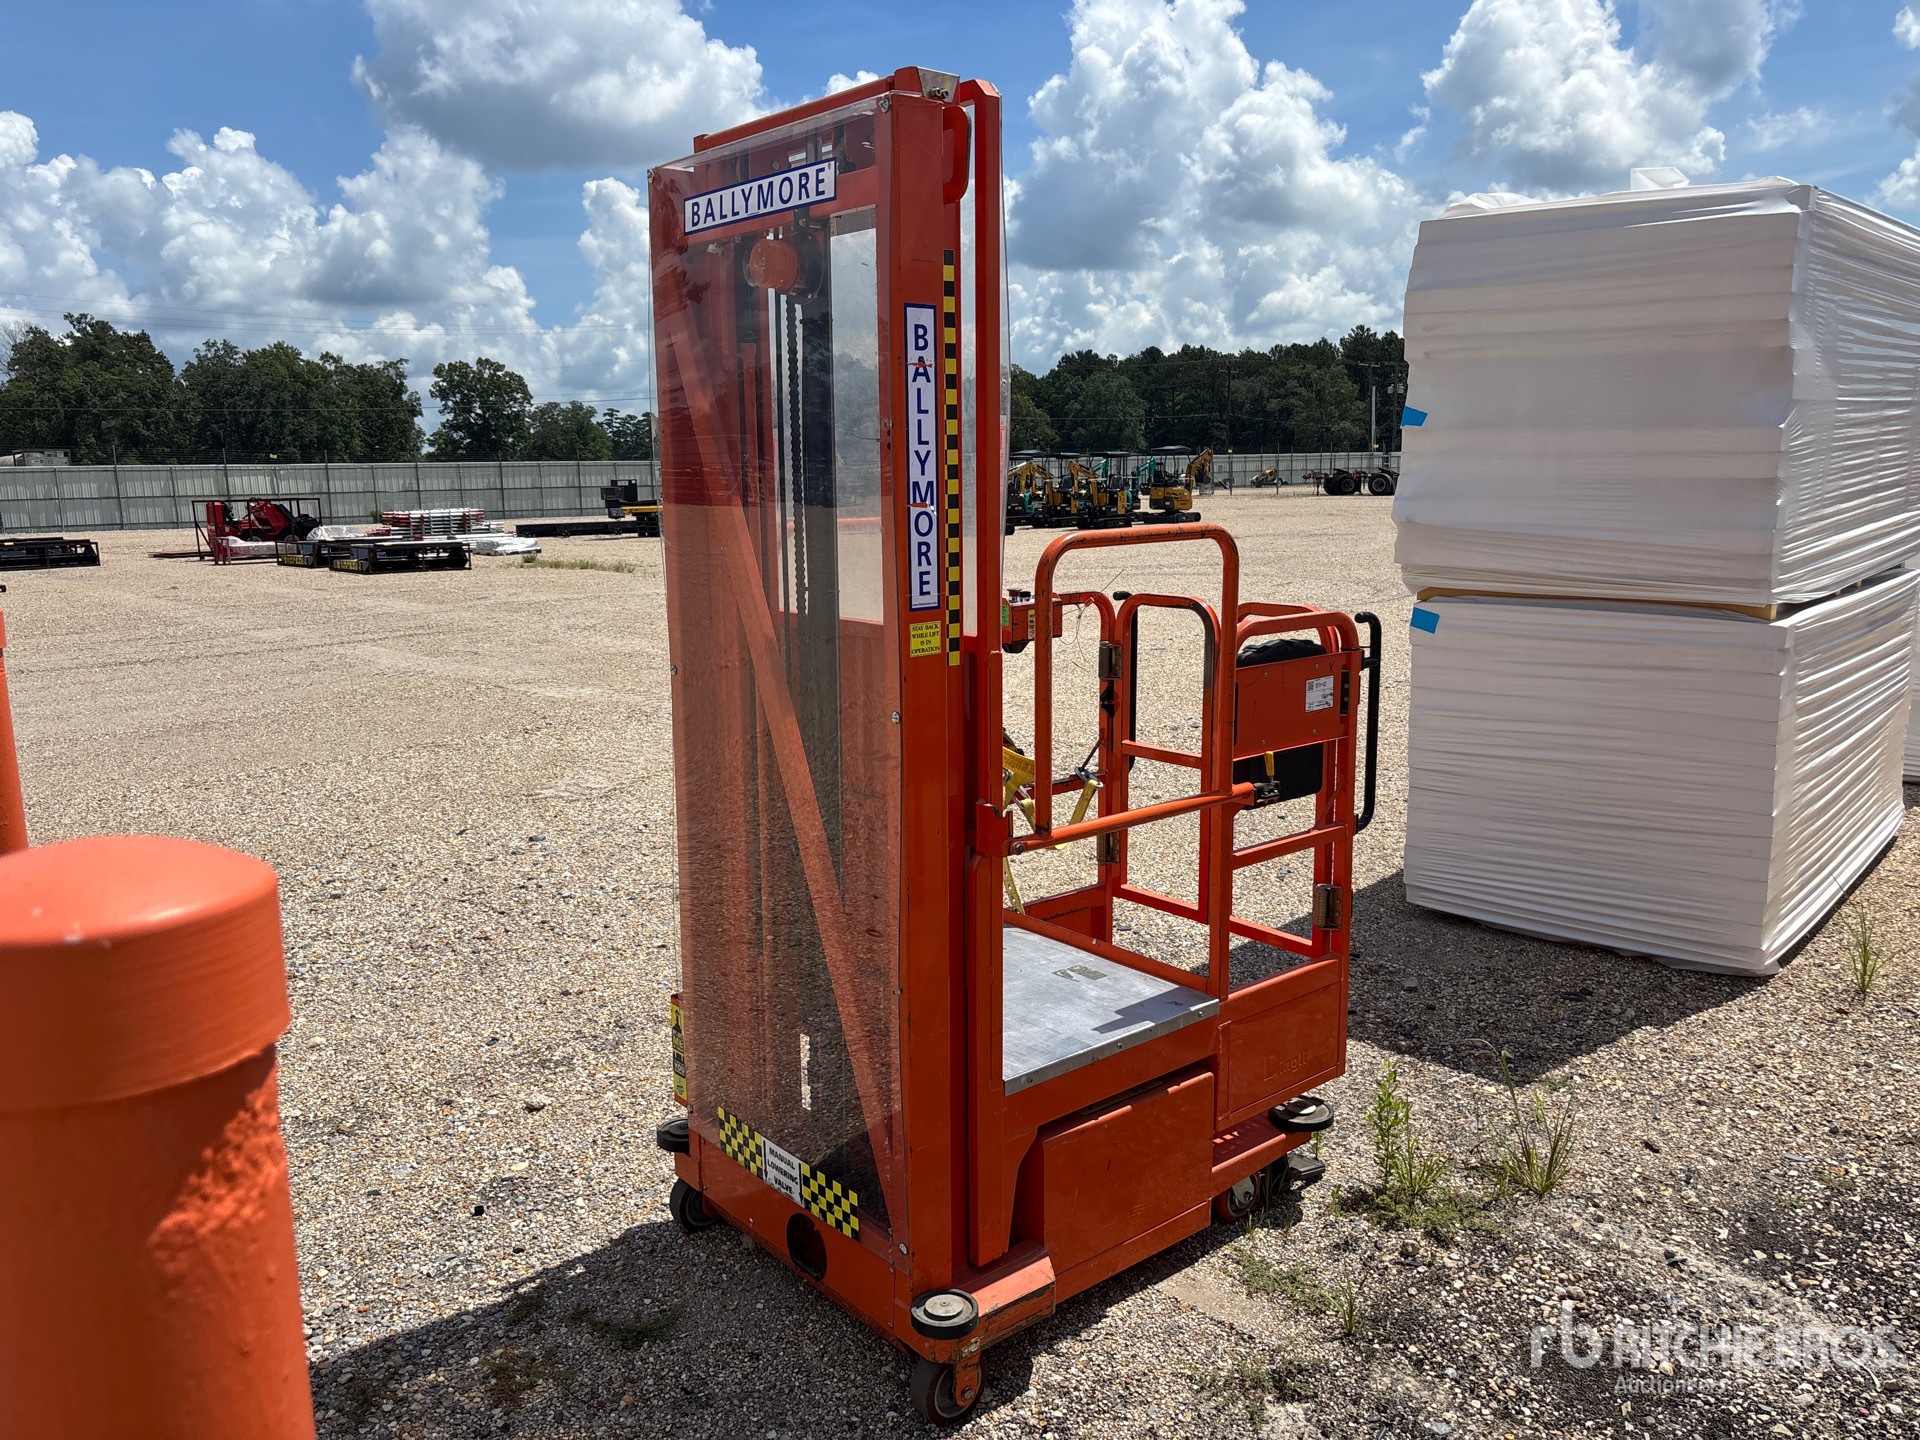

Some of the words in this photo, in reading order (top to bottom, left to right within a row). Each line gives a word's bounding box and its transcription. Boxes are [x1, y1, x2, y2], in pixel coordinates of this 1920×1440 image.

[691, 166, 826, 228] BALLYMORE
[911, 323, 935, 597] BALLYMORE
[912, 646, 940, 654] OPERATION
[1263, 1051, 1307, 1082] Dingli
[767, 1158, 799, 1186] LOWERING
[769, 1147, 796, 1171] MANUAL
[773, 1175, 794, 1195] VALVE
